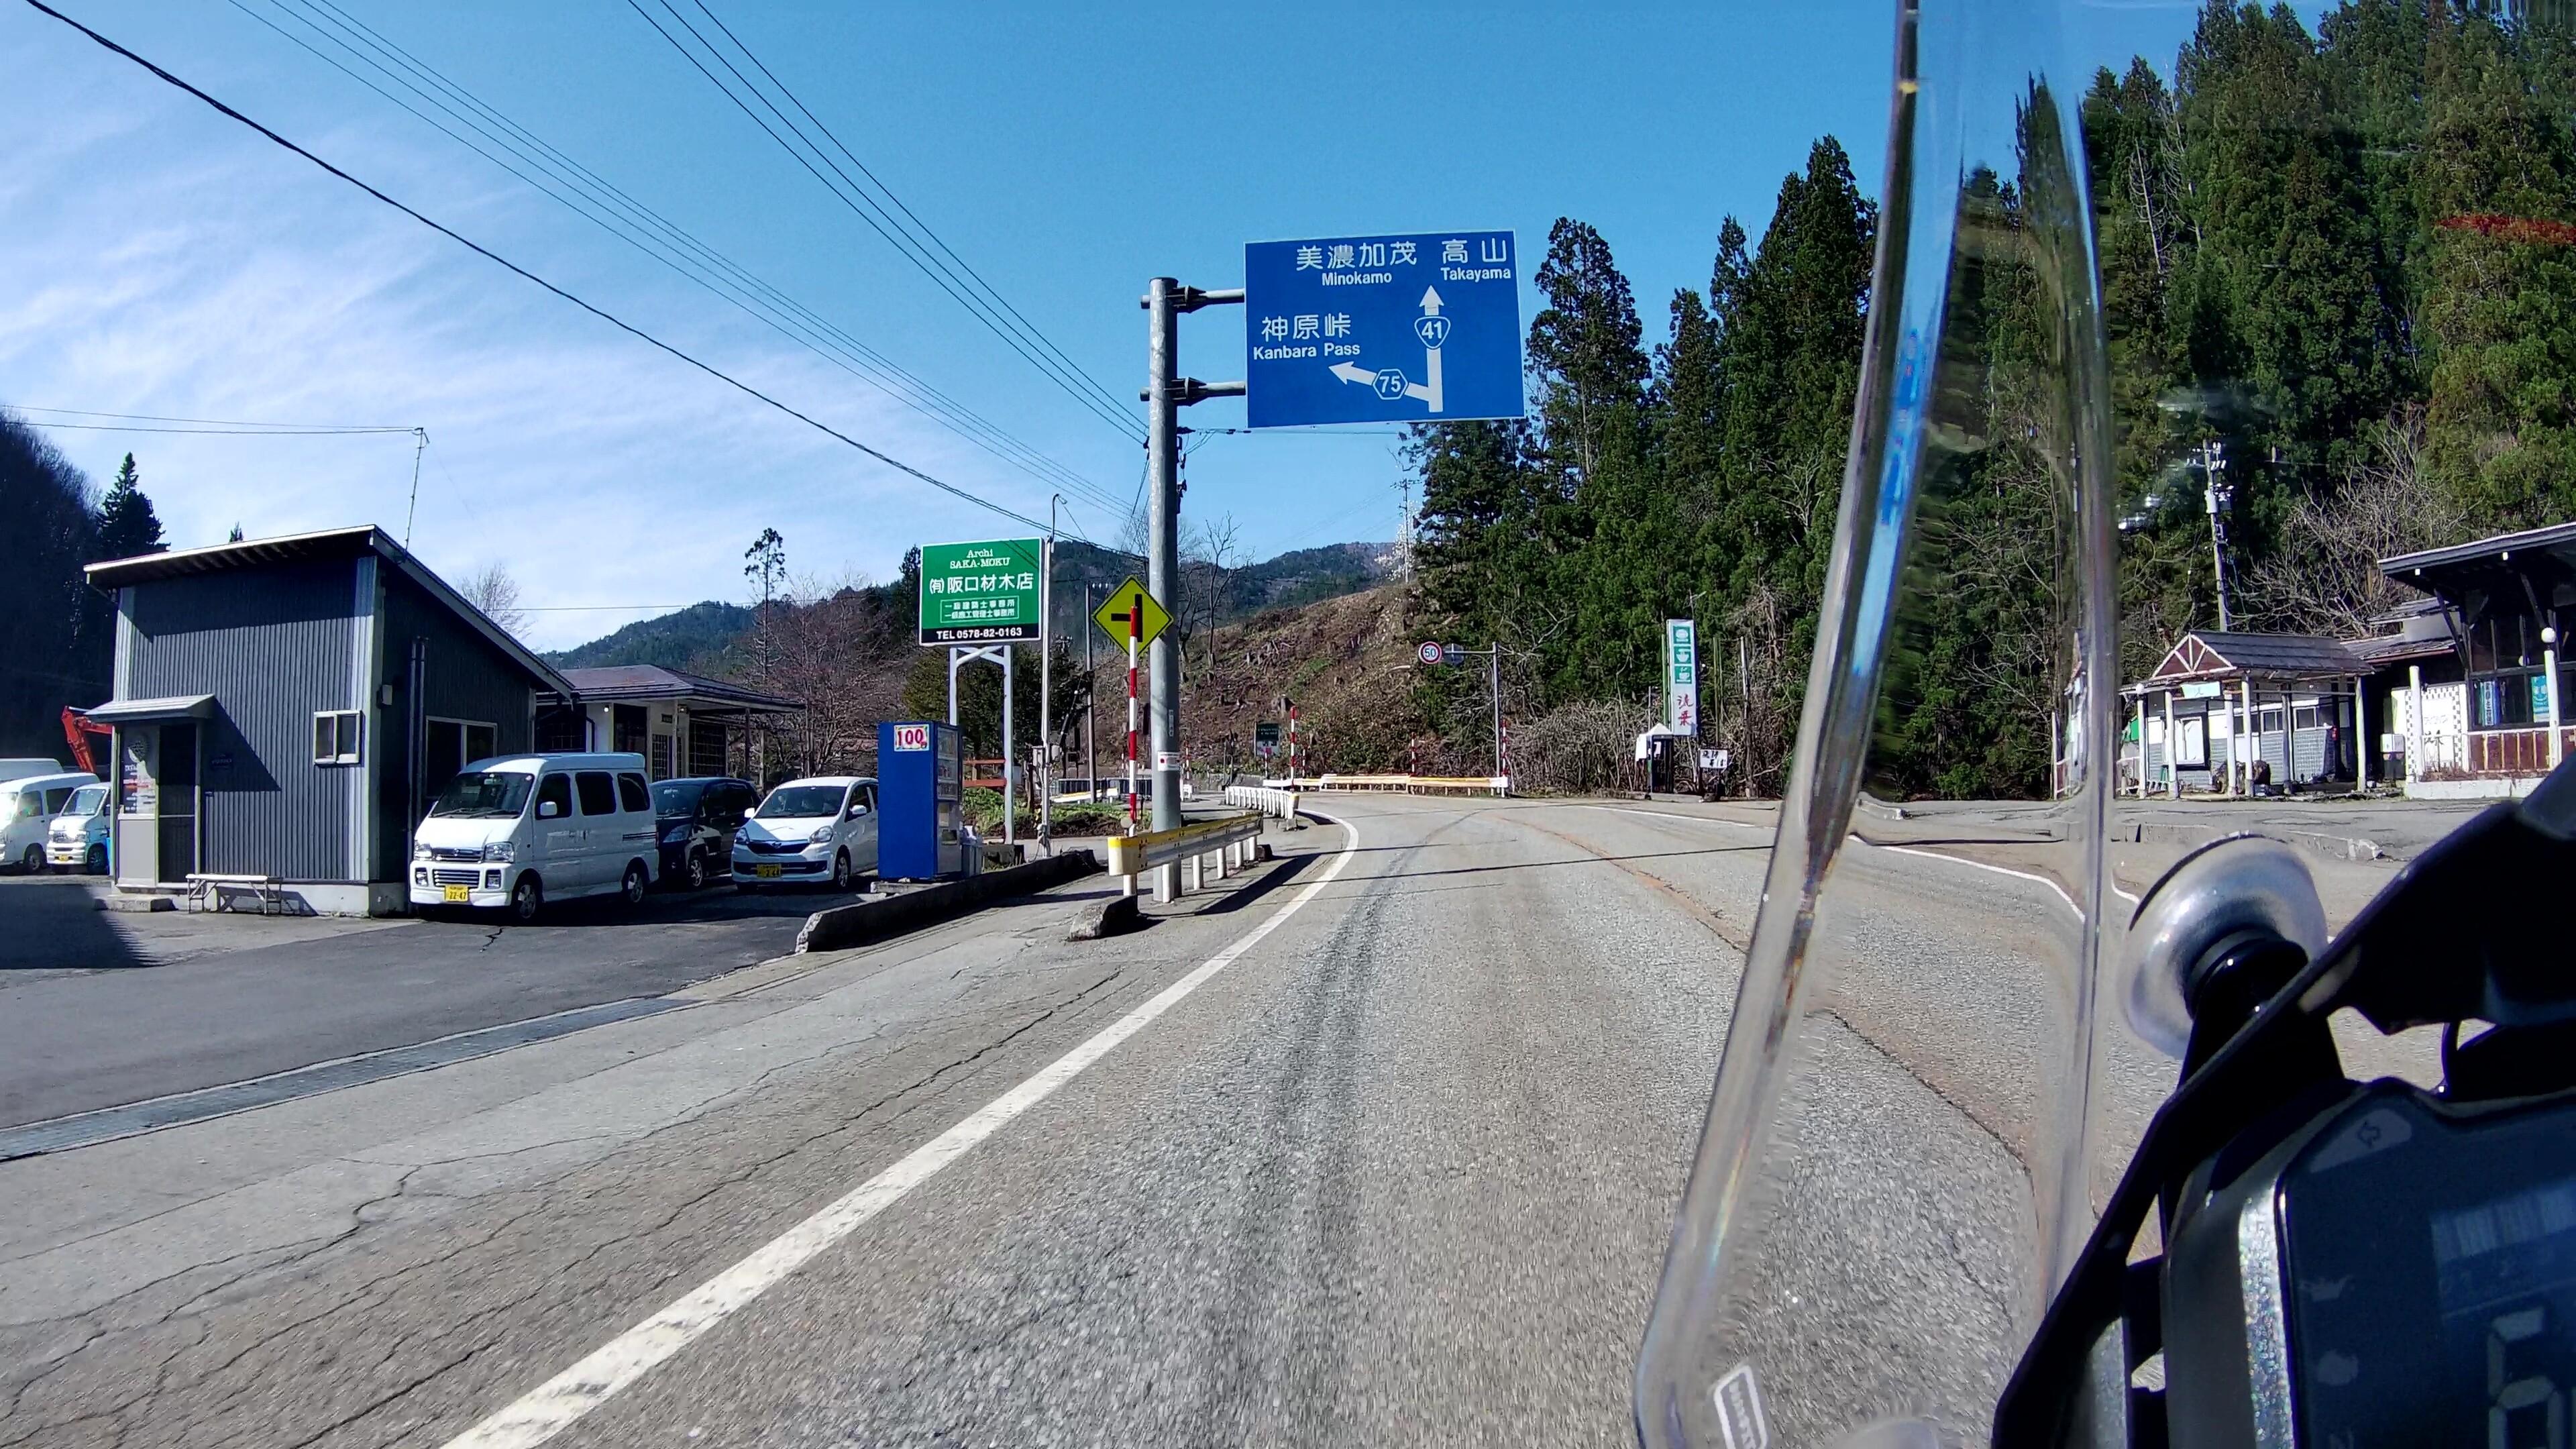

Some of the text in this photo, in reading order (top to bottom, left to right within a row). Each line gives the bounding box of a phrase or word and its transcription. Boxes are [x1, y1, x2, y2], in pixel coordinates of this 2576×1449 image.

[1296, 240, 1417, 272] 美濃加茂
[1442, 237, 1507, 264] 高山
[1322, 271, 1393, 286] Minokamo
[1440, 266, 1511, 282] Takayama
[1261, 312, 1351, 342] 神原峠
[1421, 321, 1443, 339] 41
[1252, 342, 1361, 361] Kanbara Pass
[1379, 375, 1402, 394] 75
[966, 548, 994, 558] Archi
[936, 630, 955, 640] TEL
[1424, 647, 1437, 657] 50
